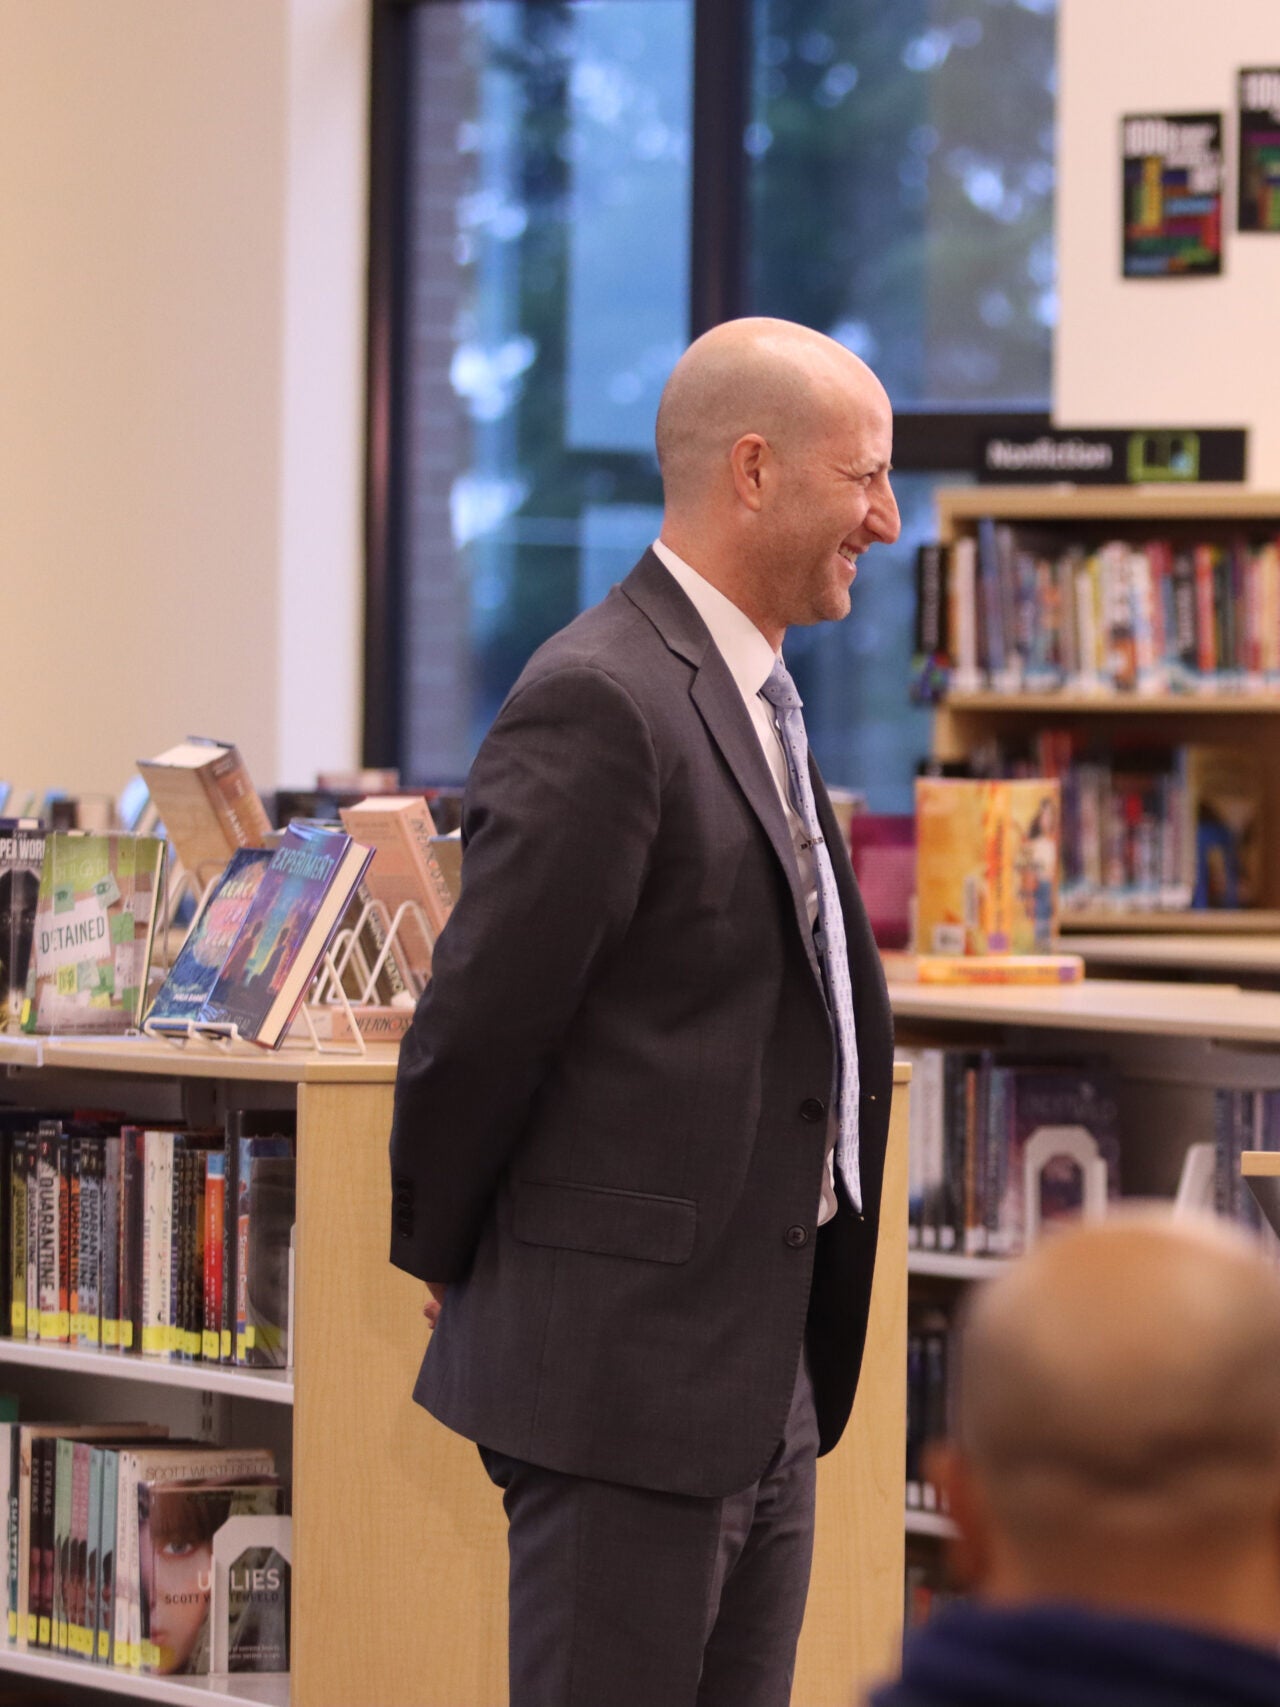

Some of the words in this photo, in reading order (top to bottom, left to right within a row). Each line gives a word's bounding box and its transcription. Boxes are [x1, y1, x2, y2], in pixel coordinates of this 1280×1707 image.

[271, 847, 335, 882] EXPERIMENT
[15, 1188, 25, 1279] QUARANTINE
[28, 1187, 37, 1265] QUARANTINE
[40, 1178, 55, 1290] QUARANTINE
[80, 1187, 89, 1288] QUARANTINE
[89, 1188, 98, 1291] QUARANTINE
[31, 1458, 40, 1513] EXTRAS
[43, 1460, 53, 1515] EXTRAS
[165, 1593, 201, 1604] SCOTT
[197, 1568, 281, 1592] ULIES
